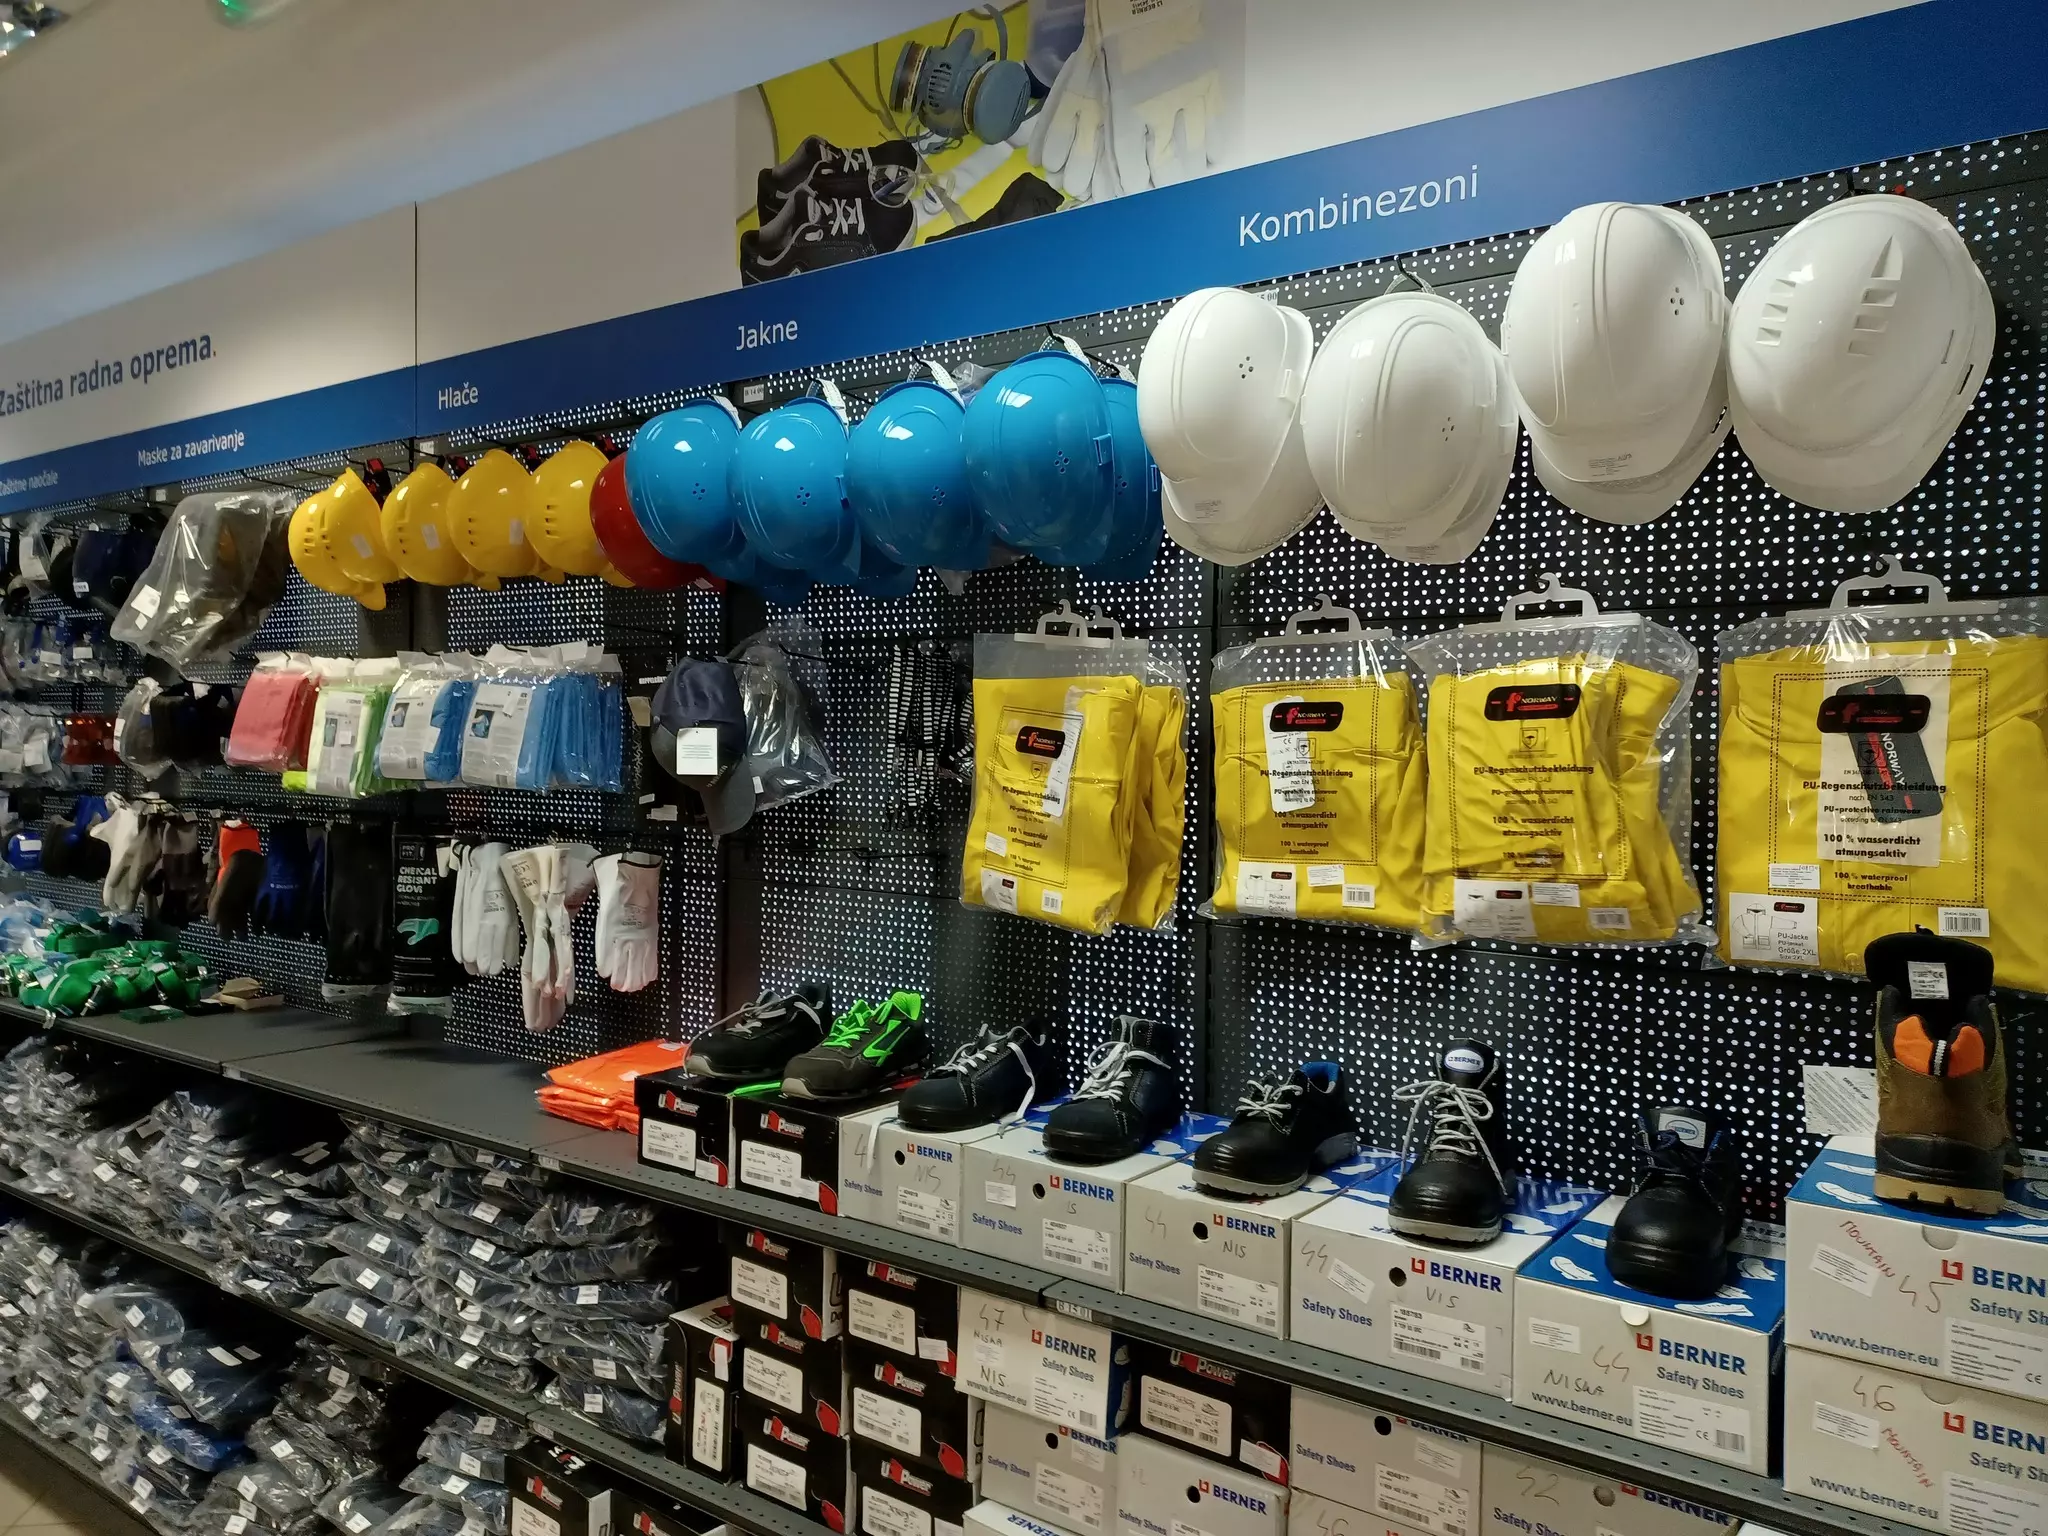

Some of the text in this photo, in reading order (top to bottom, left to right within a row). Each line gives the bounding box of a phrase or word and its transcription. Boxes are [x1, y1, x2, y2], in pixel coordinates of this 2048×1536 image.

[1238, 164, 1479, 248] Kombinezoni
[736, 319, 798, 351] Jakne
[0, 379, 63, 416] Zaštitna
[70, 359, 124, 397] radna
[438, 381, 479, 410] Hlače
[138, 429, 245, 467] Maske za zavarivanje
[1521, 696, 1559, 704] NORWAY
[1880, 732, 1905, 786] NORWAY
[1803, 781, 1947, 794] PU-Regenschutzbekleidung
[1493, 816, 1508, 824] 100
[1521, 815, 1574, 824] wasserdicht
[1823, 806, 1879, 815] PU-protective
[1823, 834, 1921, 846] 100 % wasserdicht
[1835, 848, 1907, 859] atmungsaktiv
[1834, 871, 1850, 880] 100
[1860, 873, 1909, 882] waterproof
[1847, 882, 1893, 891] breathable
[1777, 932, 1809, 941] PU-Jacke
[916, 1145, 954, 1163] BERNER
[843, 1178, 883, 1198] Safety Shoes
[1063, 1177, 1114, 1203] BERNER
[971, 1212, 1023, 1236] Safety Shoes
[1226, 1216, 1277, 1239] BERNER
[1222, 1239, 1247, 1259] NIS
[1129, 1252, 1181, 1276] Safety Shoes
[1430, 1261, 1502, 1293] BERNER
[1425, 1285, 1460, 1309] VIS
[1898, 1274, 1954, 1315] 45
[1302, 1297, 1372, 1328] Safety Shoes
[1970, 1297, 2023, 1324] Safety
[1044, 1335, 1097, 1363] BERNER
[1659, 1338, 1748, 1376] BERNER
[1809, 1326, 1939, 1368] www.berner.eu
[1042, 1357, 1095, 1383] Safety Shoes
[1170, 1350, 1236, 1381] U Power
[966, 1379, 1027, 1408] www.berner.eu
[1656, 1365, 1745, 1400] Safety Shoes
[1852, 1374, 1896, 1412] 46
[1531, 1391, 1633, 1428] www.berner.eu
[1296, 1443, 1356, 1473] Safety Shoes
[1970, 1452, 2023, 1479] Safety
[1213, 1483, 1267, 1515] BERNER
[1809, 1475, 1939, 1522] www.berner.eu
[1118, 1508, 1141, 1527] Safety
[1493, 1507, 1534, 1535] Safety
